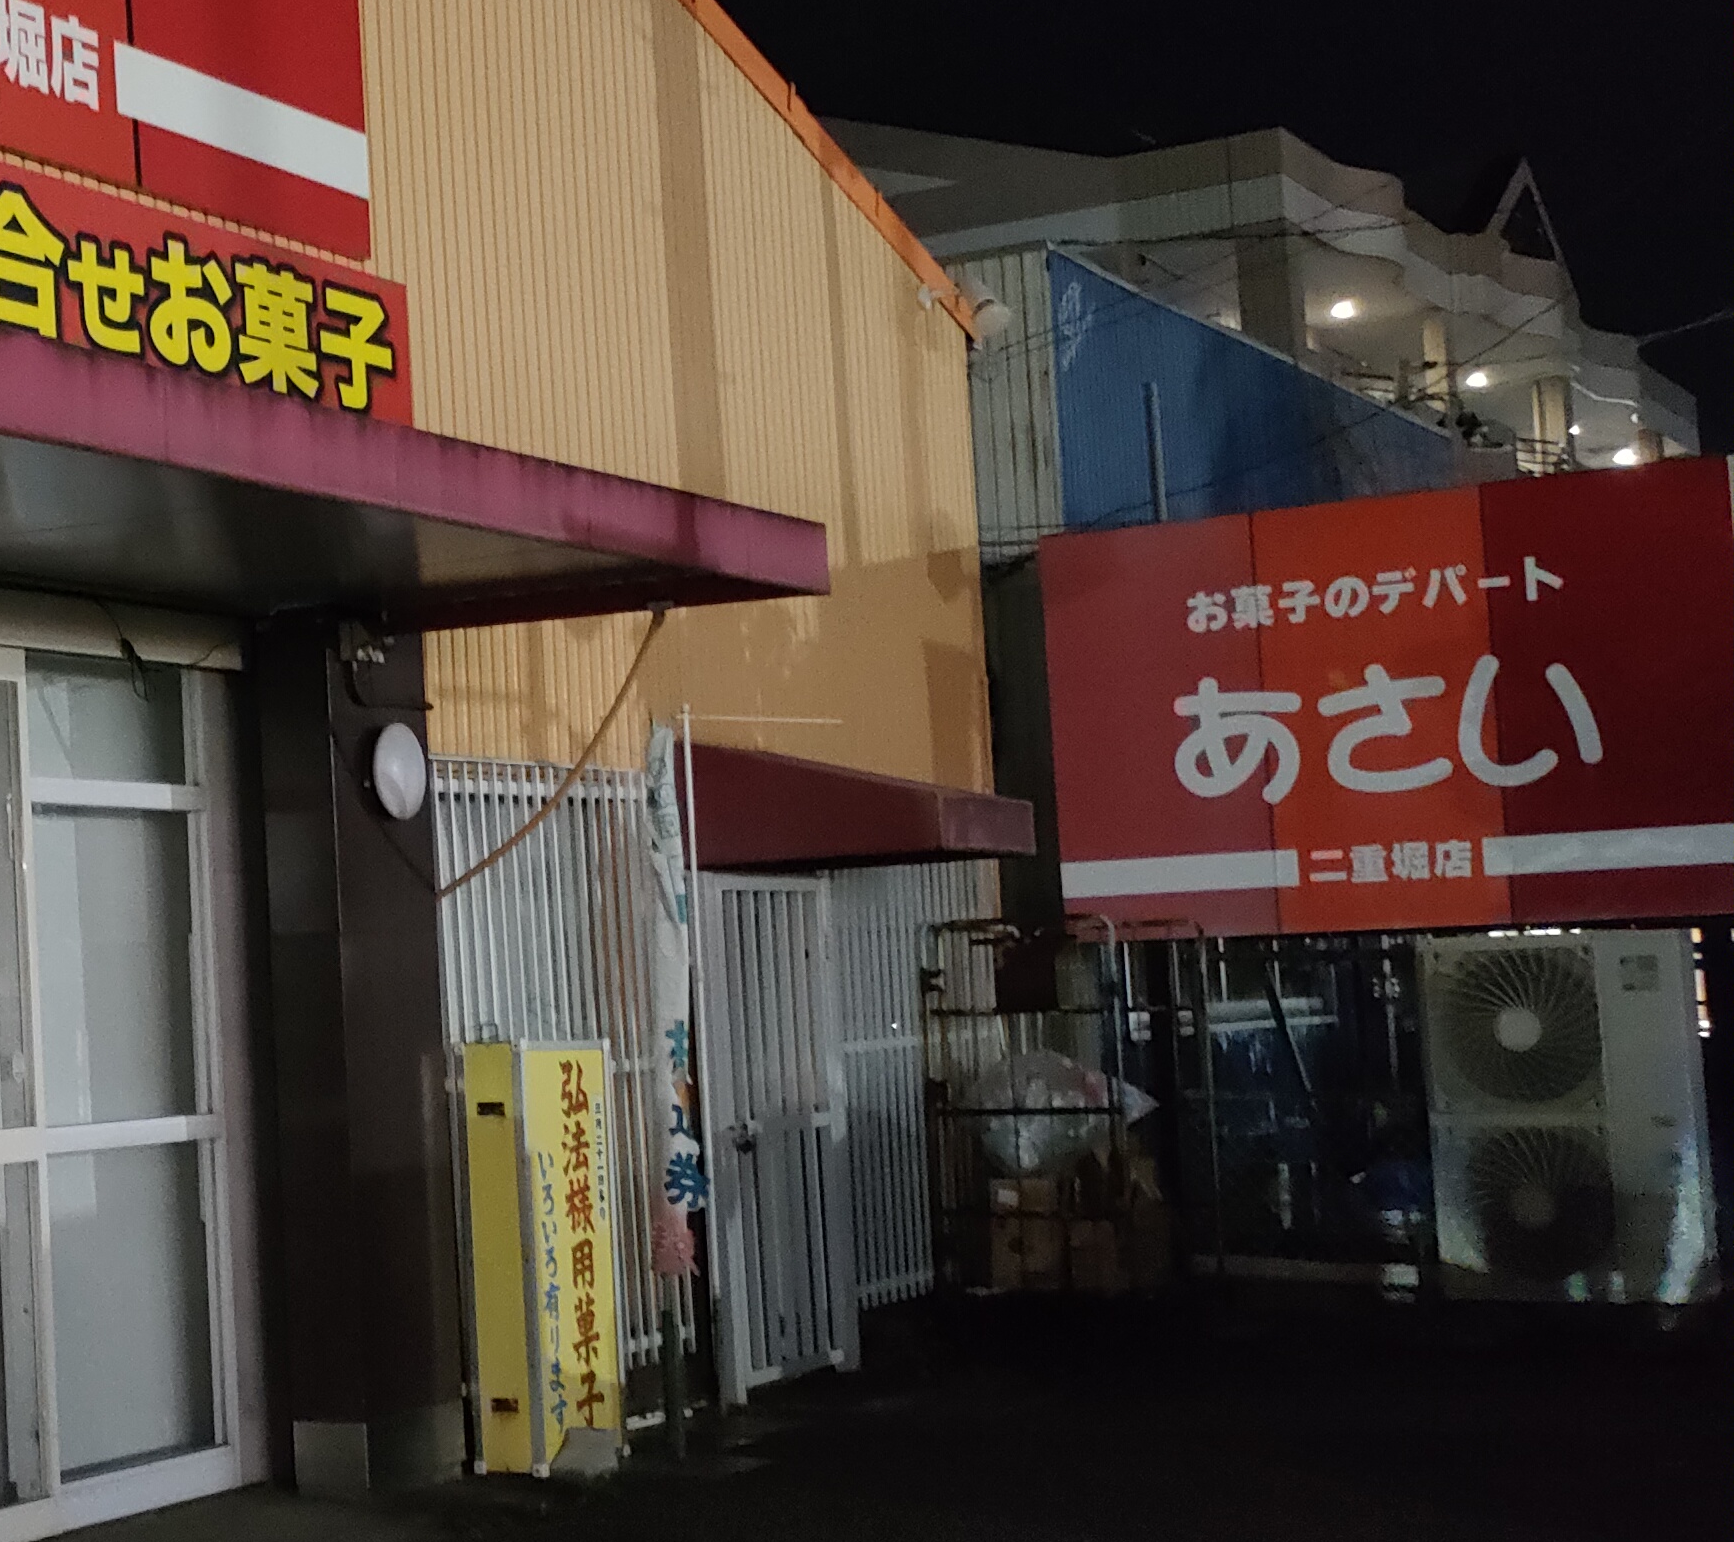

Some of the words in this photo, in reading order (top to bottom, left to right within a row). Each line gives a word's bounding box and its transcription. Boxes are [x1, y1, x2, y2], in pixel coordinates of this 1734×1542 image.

[1186, 555, 1564, 634] お菓子のデパート
[1173, 654, 1604, 806] あさい
[1309, 839, 1472, 884] 二重堀店
